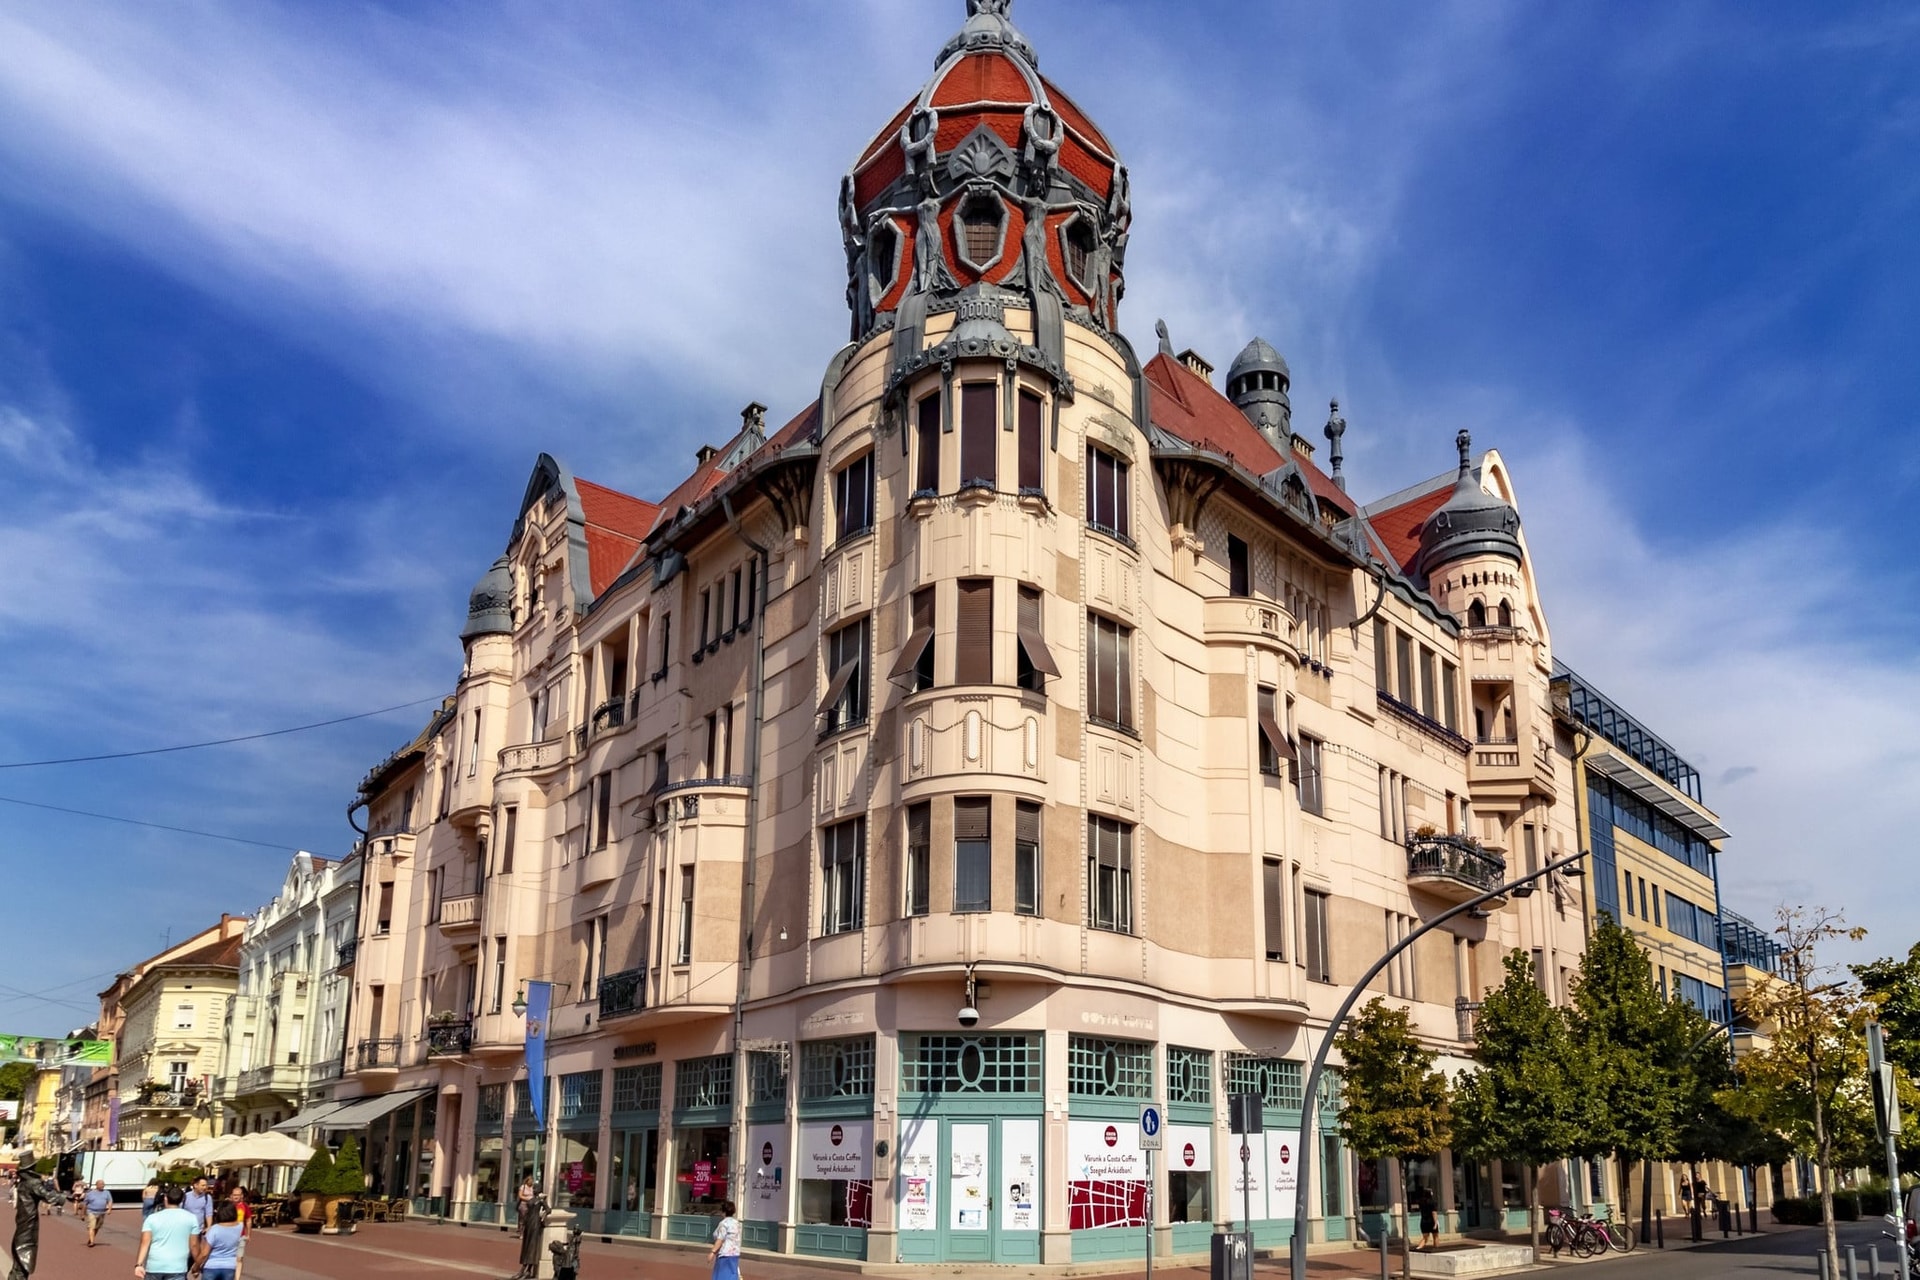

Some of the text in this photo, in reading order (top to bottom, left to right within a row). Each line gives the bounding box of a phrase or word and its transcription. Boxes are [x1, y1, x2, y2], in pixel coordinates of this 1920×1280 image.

[832, 1153, 845, 1161] Costa
[846, 1153, 861, 1161] Coffee
[1106, 1154, 1121, 1162] Costa
[1121, 1154, 1138, 1162] Coffee
[816, 1164, 832, 1176] Szeged
[1089, 1165, 1107, 1176] Szeged
